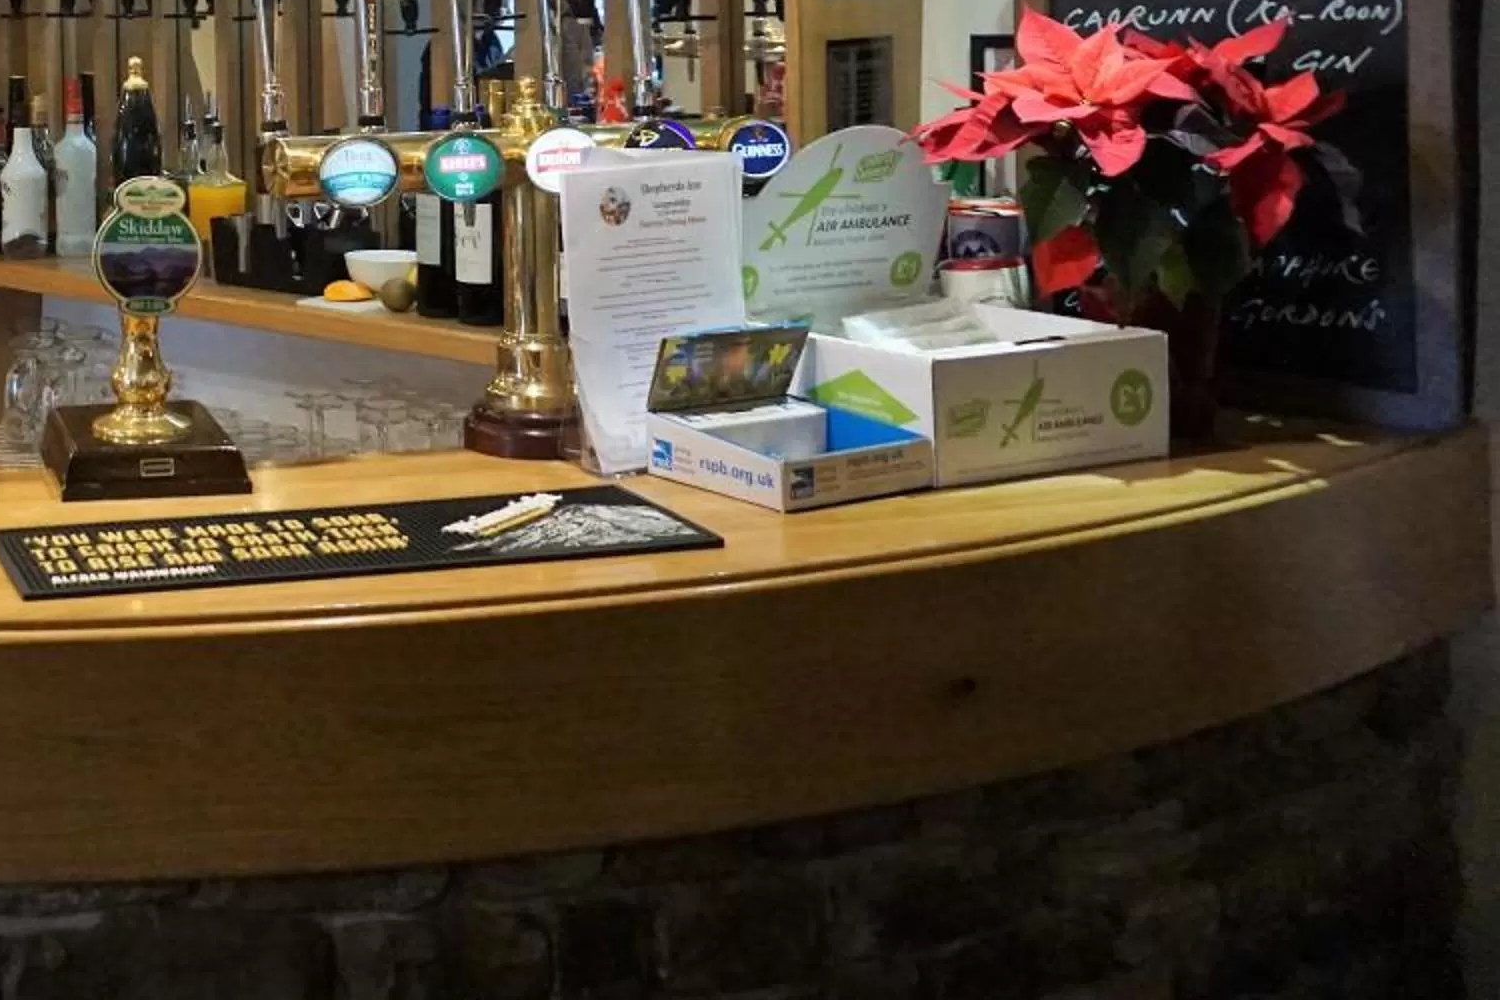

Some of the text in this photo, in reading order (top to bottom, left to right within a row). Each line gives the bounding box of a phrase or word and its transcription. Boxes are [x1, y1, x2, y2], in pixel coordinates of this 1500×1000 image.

[1292, 47, 1373, 74] GIN
[732, 143, 784, 159] GUINNESS
[118, 219, 182, 236] Skiddaw
[840, 213, 912, 230] AMBULANCE
[98, 527, 177, 543] WERE
[184, 522, 263, 539] MADE
[266, 519, 305, 532] TO
[31, 547, 69, 560] TO
[77, 540, 175, 557] CRASH
[181, 537, 220, 550] TO
[38, 559, 78, 574] TO
[87, 554, 156, 571] RISE
[162, 549, 224, 566] AND
[232, 543, 311, 561] SOAR
